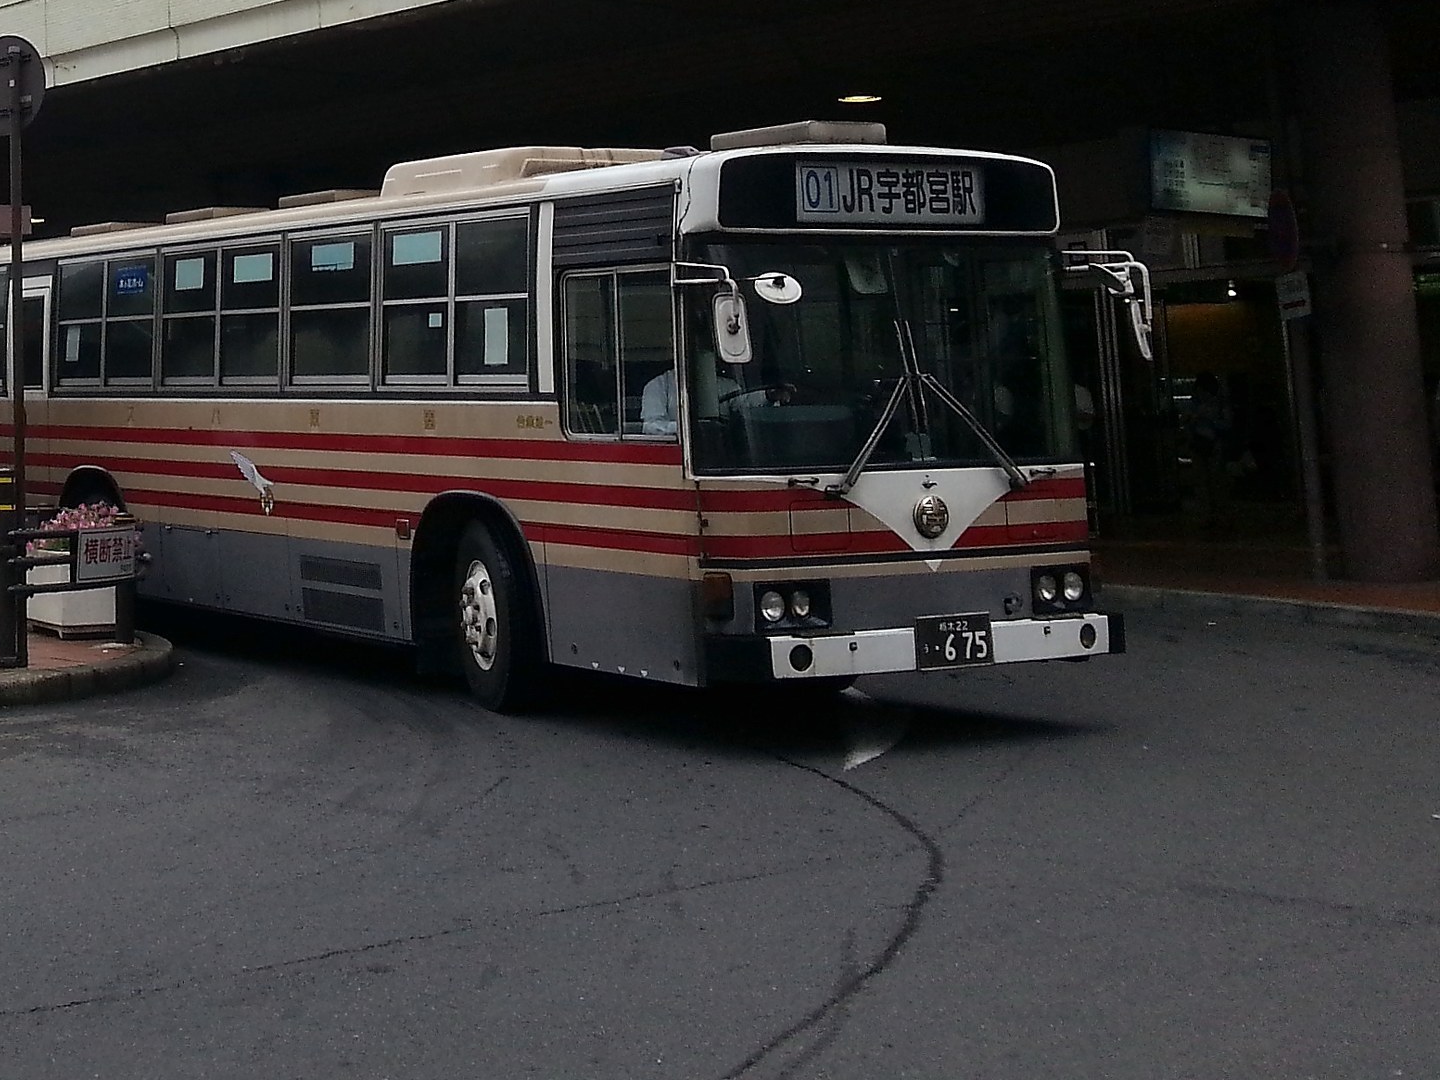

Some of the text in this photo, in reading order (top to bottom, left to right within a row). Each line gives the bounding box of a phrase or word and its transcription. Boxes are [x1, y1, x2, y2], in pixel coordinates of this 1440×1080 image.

[805, 168, 976, 215] 01 JR宇都宮駅
[85, 535, 132, 564] 横断禁止
